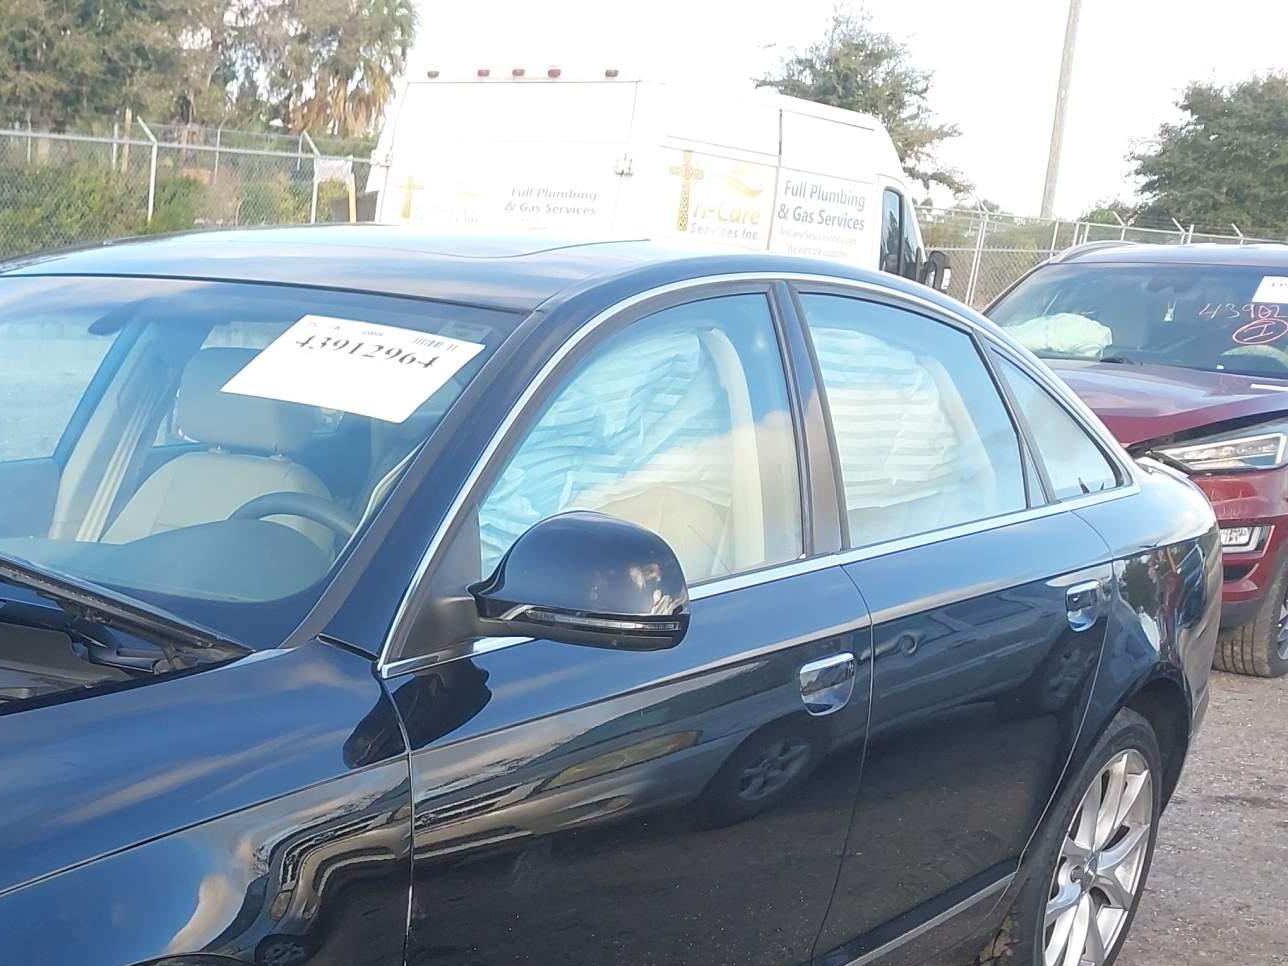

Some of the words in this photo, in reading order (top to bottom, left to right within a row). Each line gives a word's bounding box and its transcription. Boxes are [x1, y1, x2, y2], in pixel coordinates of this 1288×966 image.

[512, 186, 534, 199] Full
[536, 186, 598, 204] Plumbing
[519, 201, 541, 213] Gas
[544, 202, 597, 216] Services
[784, 179, 808, 199] Full
[809, 183, 867, 213] Plumbing
[777, 202, 790, 221] &
[793, 205, 815, 224] Gas
[817, 208, 865, 231] Services
[295, 335, 441, 369] 43912964
